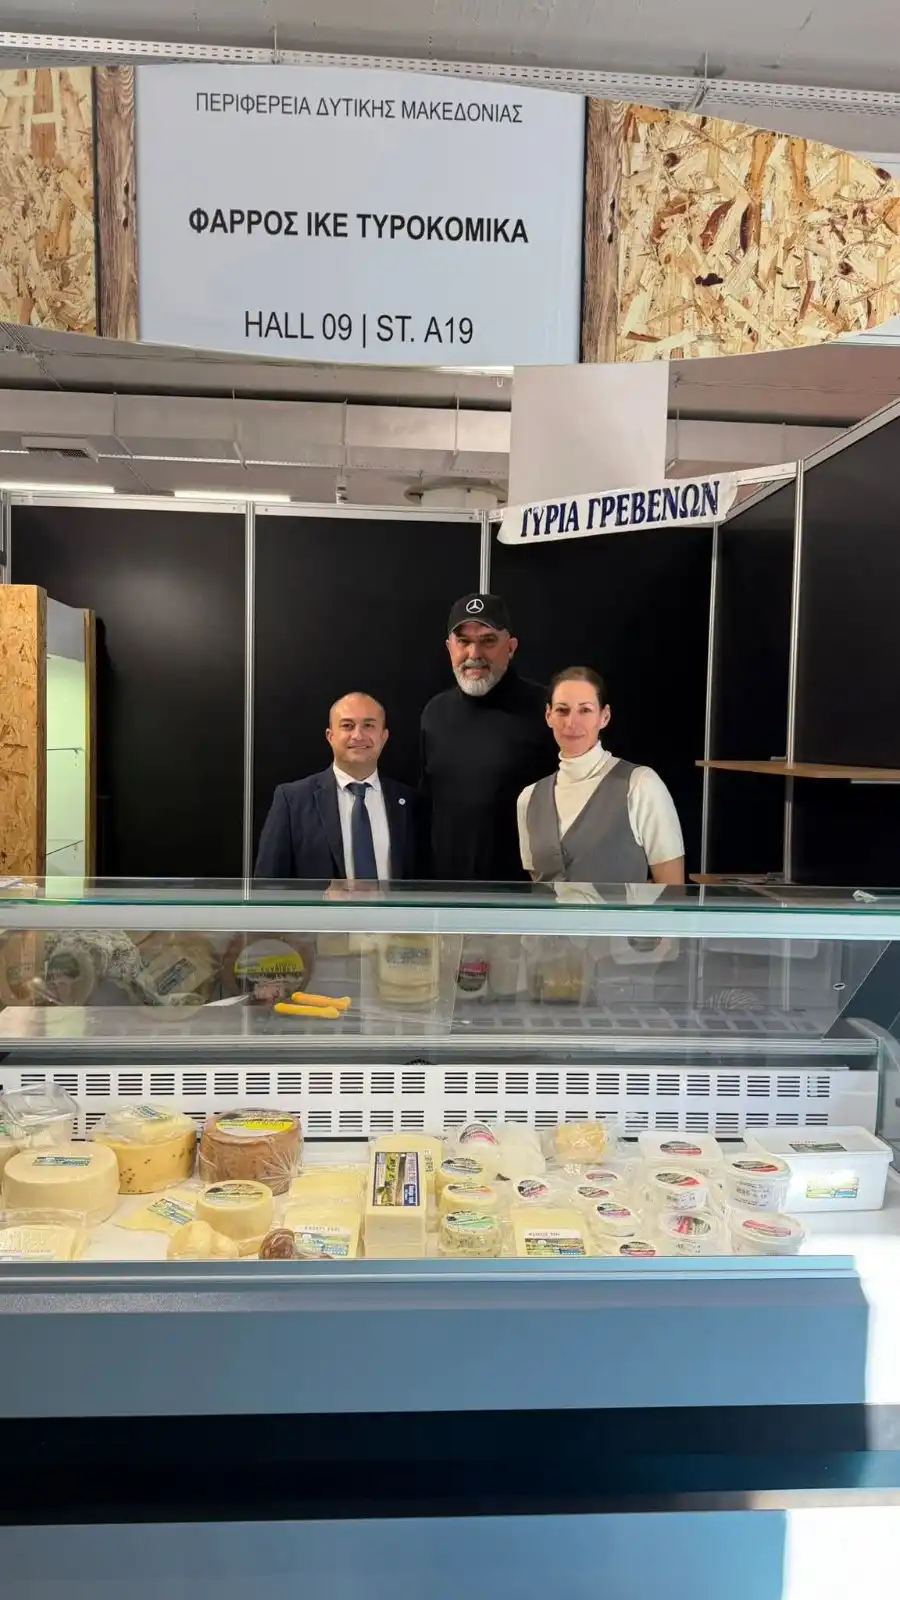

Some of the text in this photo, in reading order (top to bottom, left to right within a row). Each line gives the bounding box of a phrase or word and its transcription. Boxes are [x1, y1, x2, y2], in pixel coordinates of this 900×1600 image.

[196, 92, 524, 124] ΠΕΡΙΦΕΡΕΙΑ ΔΥΤΙΚΗΣ ΜΑΚΕΔΟΝΙΑΣ
[188, 207, 529, 244] ΦΑΡΡΟΣ ΙΚΕ ΤΥΡΟΚΟΜΙΚΑ
[244, 310, 315, 340] HALL
[321, 312, 353, 341] 09
[376, 314, 415, 343] ST.
[423, 315, 474, 345] A19
[586, 480, 720, 530] ΓΡΕΒΕΝΩΝ
